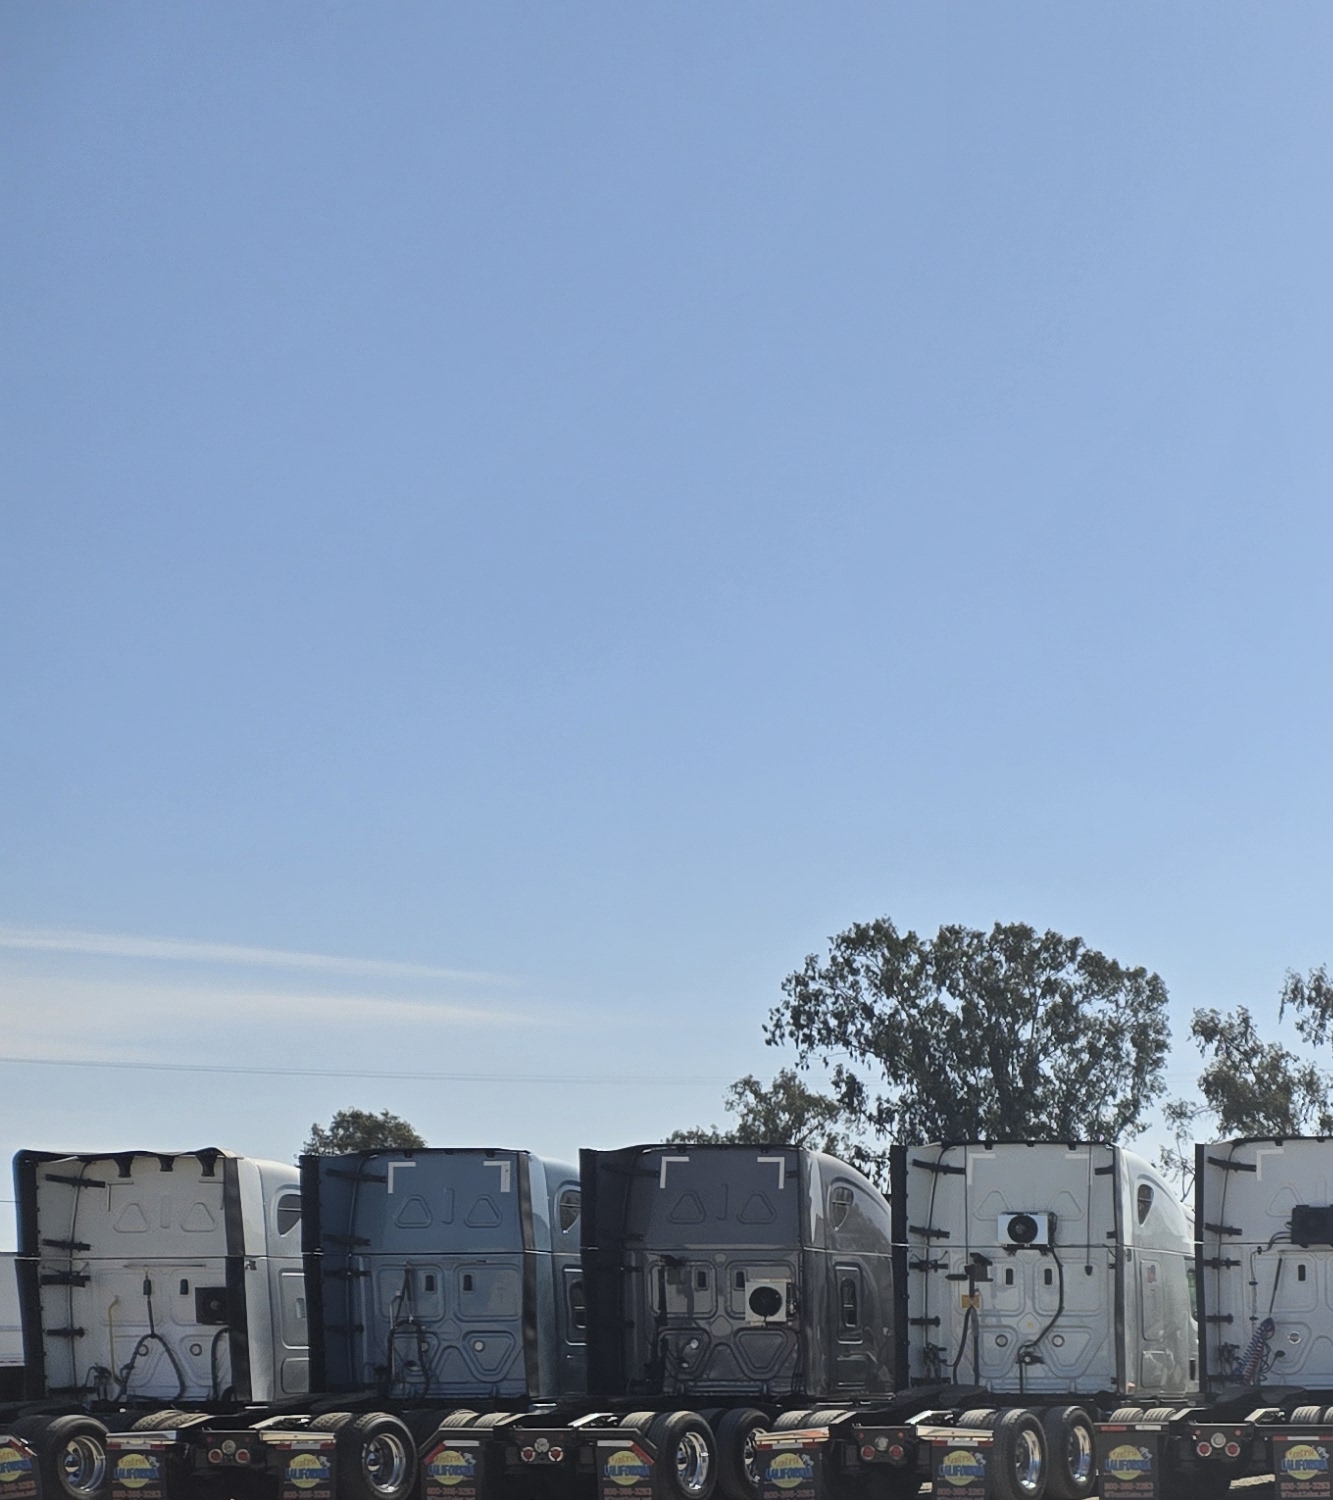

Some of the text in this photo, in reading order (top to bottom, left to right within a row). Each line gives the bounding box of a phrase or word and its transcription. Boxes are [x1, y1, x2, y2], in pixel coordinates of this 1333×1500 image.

[427, 1464, 475, 1477] CALIFORNIA
[603, 1464, 650, 1477] CALIFORNIA
[938, 1464, 986, 1477] CALIFORNIA
[1103, 1458, 1152, 1471] CALIFORNIA
[1280, 1458, 1328, 1471] CALIFORNIA
[113, 1467, 160, 1479] CALIFORNIA
[285, 1467, 330, 1479] CALIFORNIA
[765, 1466, 813, 1480] CALIFORNIA
